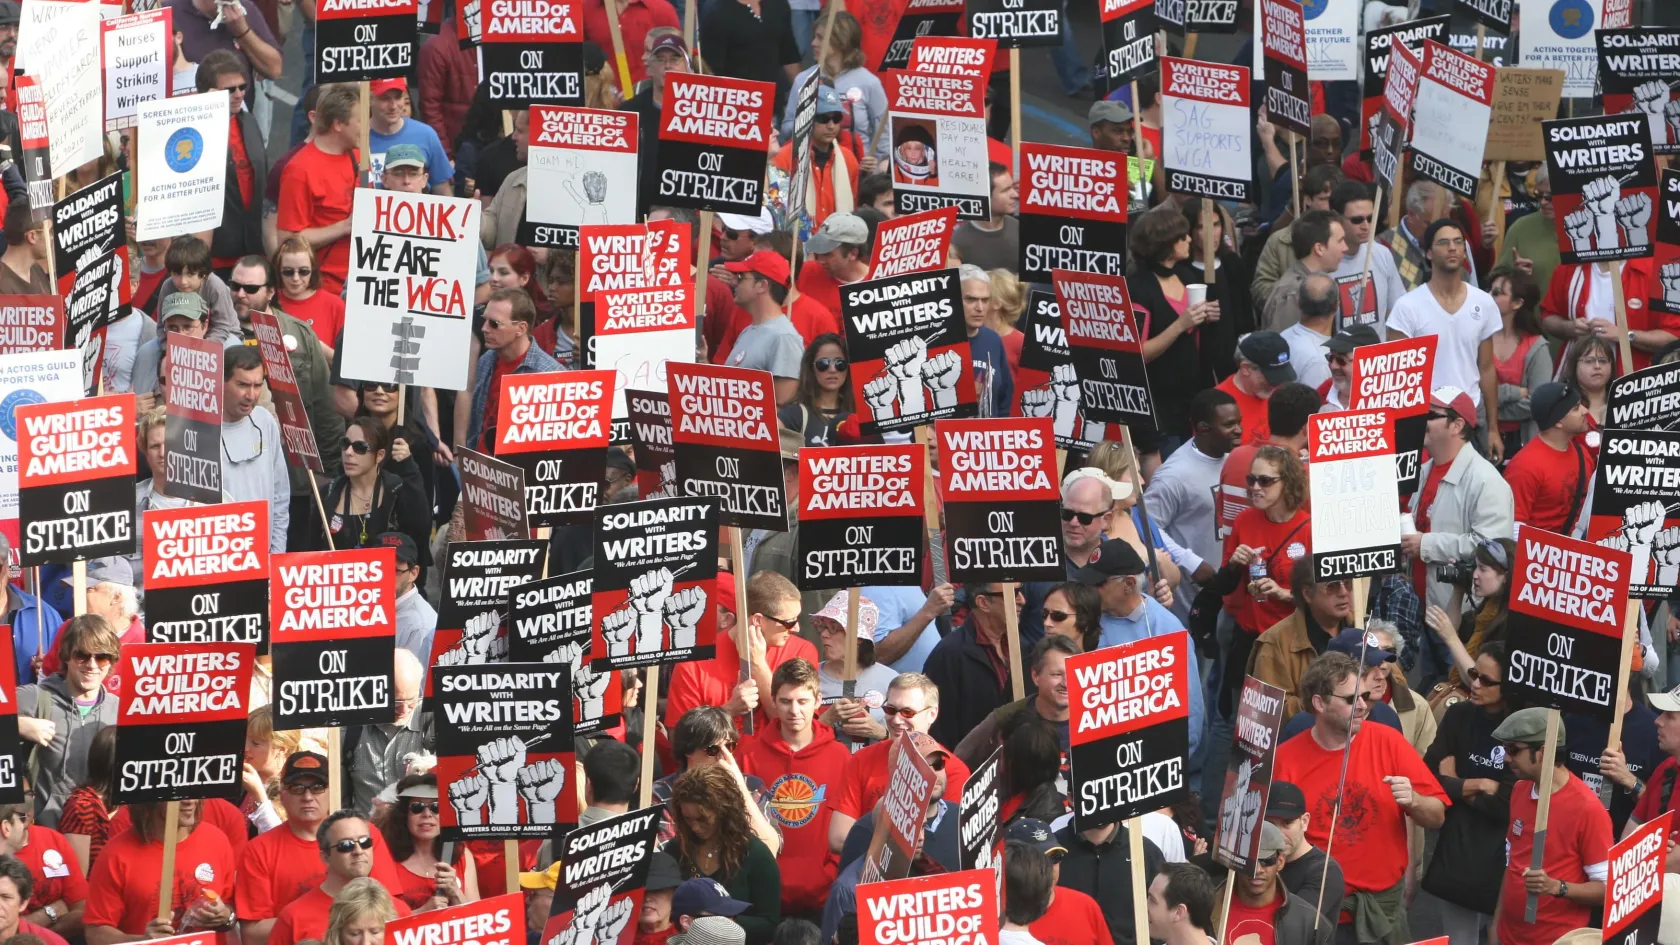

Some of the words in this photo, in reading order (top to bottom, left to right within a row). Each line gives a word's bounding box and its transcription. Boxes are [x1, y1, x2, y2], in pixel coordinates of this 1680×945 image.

[106, 17, 139, 27] California
[140, 11, 162, 20] Nurses
[491, 0, 549, 17] GUILD
[551, 4, 570, 16] OF
[116, 18, 153, 29] Association
[354, 25, 377, 43] ON
[488, 18, 576, 34] AMERICA
[119, 33, 155, 47] Nurses
[116, 51, 158, 69] Support
[322, 43, 411, 73] STRIKE
[520, 50, 543, 69] ON
[1431, 45, 1488, 79] WRITERS
[117, 72, 158, 89] Striking
[897, 75, 973, 91] WRITERS
[1170, 62, 1240, 80] WRITERS
[1172, 72, 1223, 88] GUILD
[1224, 81, 1236, 90] OF
[1427, 67, 1485, 100] AMERICA
[1431, 59, 1471, 82] GUILD
[1473, 78, 1484, 87] OF
[489, 72, 579, 99] STRIKE
[672, 82, 762, 108] WRITERS
[899, 87, 951, 100] GUILD
[953, 91, 970, 101] OF
[1169, 84, 1242, 102] AMERICA
[117, 93, 156, 109] Writers
[143, 110, 172, 119] SCREEN
[174, 105, 202, 115] ACTORS
[204, 102, 225, 112] GUILD
[674, 100, 736, 121] GUILD
[737, 110, 759, 124] OF
[896, 96, 976, 112] AMERICA
[156, 115, 195, 126] SUPPORTS
[197, 112, 213, 121] WGA
[940, 118, 984, 134] RESIDUALS
[1174, 99, 1214, 129] SAG
[667, 117, 762, 142] AMERICA
[941, 133, 960, 143] PAY
[963, 133, 980, 144] FOR
[1176, 131, 1241, 152] SUPPORTS
[1550, 121, 1641, 142] SOLIDARITY
[698, 152, 723, 172] ON
[942, 159, 979, 169] HEALTH
[955, 146, 967, 157] MY
[1176, 150, 1211, 169] WGA
[1553, 143, 1644, 168] WRITERS
[1027, 152, 1117, 178] WRITERS
[1414, 154, 1473, 195] STRIKE
[144, 195, 158, 203] FOR
[167, 189, 192, 199] BETTER
[194, 183, 220, 195] FUTURE
[151, 181, 176, 193] ACTING
[179, 176, 213, 189] TOGETHER
[660, 169, 758, 205] STRIKE
[1031, 170, 1093, 193] GUILD
[1094, 180, 1115, 195] OF
[1172, 172, 1245, 199] STRIKE
[901, 194, 982, 216] STRIKE
[1027, 188, 1120, 213] AMERICA
[375, 196, 472, 240] HONK!
[1060, 225, 1084, 246] ON
[355, 236, 392, 272] WE
[394, 240, 441, 277] ARE
[1025, 244, 1121, 276] STRIKE
[356, 276, 399, 308] THE
[407, 276, 466, 317] WGA
[849, 276, 950, 306] SOLIDARITY
[891, 298, 911, 307] WITH
[852, 299, 953, 333] WRITERS
[25, 406, 123, 436] WRITERS
[1316, 412, 1385, 431] WRITERS
[30, 432, 97, 456] GUILD
[99, 431, 121, 446] OF
[944, 429, 1043, 451] WRITERS
[1316, 438, 1388, 457] AMERICA
[1319, 428, 1367, 444] GUILD
[1368, 428, 1382, 438] OF
[26, 447, 129, 477] AMERICA
[952, 451, 1019, 471] GUILD
[1020, 455, 1042, 469] OF
[949, 471, 1051, 491] AMERICA
[64, 490, 90, 514] ON
[602, 505, 711, 530] SOLIDARITY
[645, 526, 665, 534] WITH
[988, 511, 1014, 532] ON
[26, 511, 130, 554] STRIKE
[603, 530, 707, 561] WRITERS
[954, 537, 1059, 569] STRIKE
[1320, 549, 1395, 577] STRIKE
[1525, 539, 1619, 582] WRITERS
[279, 560, 383, 587] WRITERS
[1526, 562, 1592, 603] GUILD
[1593, 586, 1614, 602] OF
[284, 586, 357, 609] GUILD
[357, 589, 381, 605] OF
[1518, 583, 1617, 627] AMERICA
[279, 606, 388, 632] AMERICA
[1548, 633, 1575, 660] ON
[131, 652, 240, 676] WRITERS
[319, 650, 348, 675] ON
[1075, 646, 1175, 688] WRITERS
[135, 674, 211, 697] GUILD
[212, 675, 236, 690] OF
[442, 672, 561, 691] SOLIDARITY
[1509, 650, 1612, 706] STRIKE
[126, 691, 241, 716] AMERICA
[279, 675, 389, 716] STRIKE
[1081, 675, 1150, 710] GUILD
[1150, 673, 1172, 691] OF
[443, 700, 560, 723] WRITERS
[1078, 688, 1181, 733] AMERICA
[165, 732, 196, 755] ON
[1116, 740, 1143, 768] ON
[121, 754, 237, 792] STRIKE
[1081, 756, 1183, 817] STRIKE
[1612, 827, 1663, 881] WRITERS
[1613, 863, 1645, 902] GUILD
[1644, 855, 1659, 879] OF
[1607, 877, 1660, 928] AMERICA
